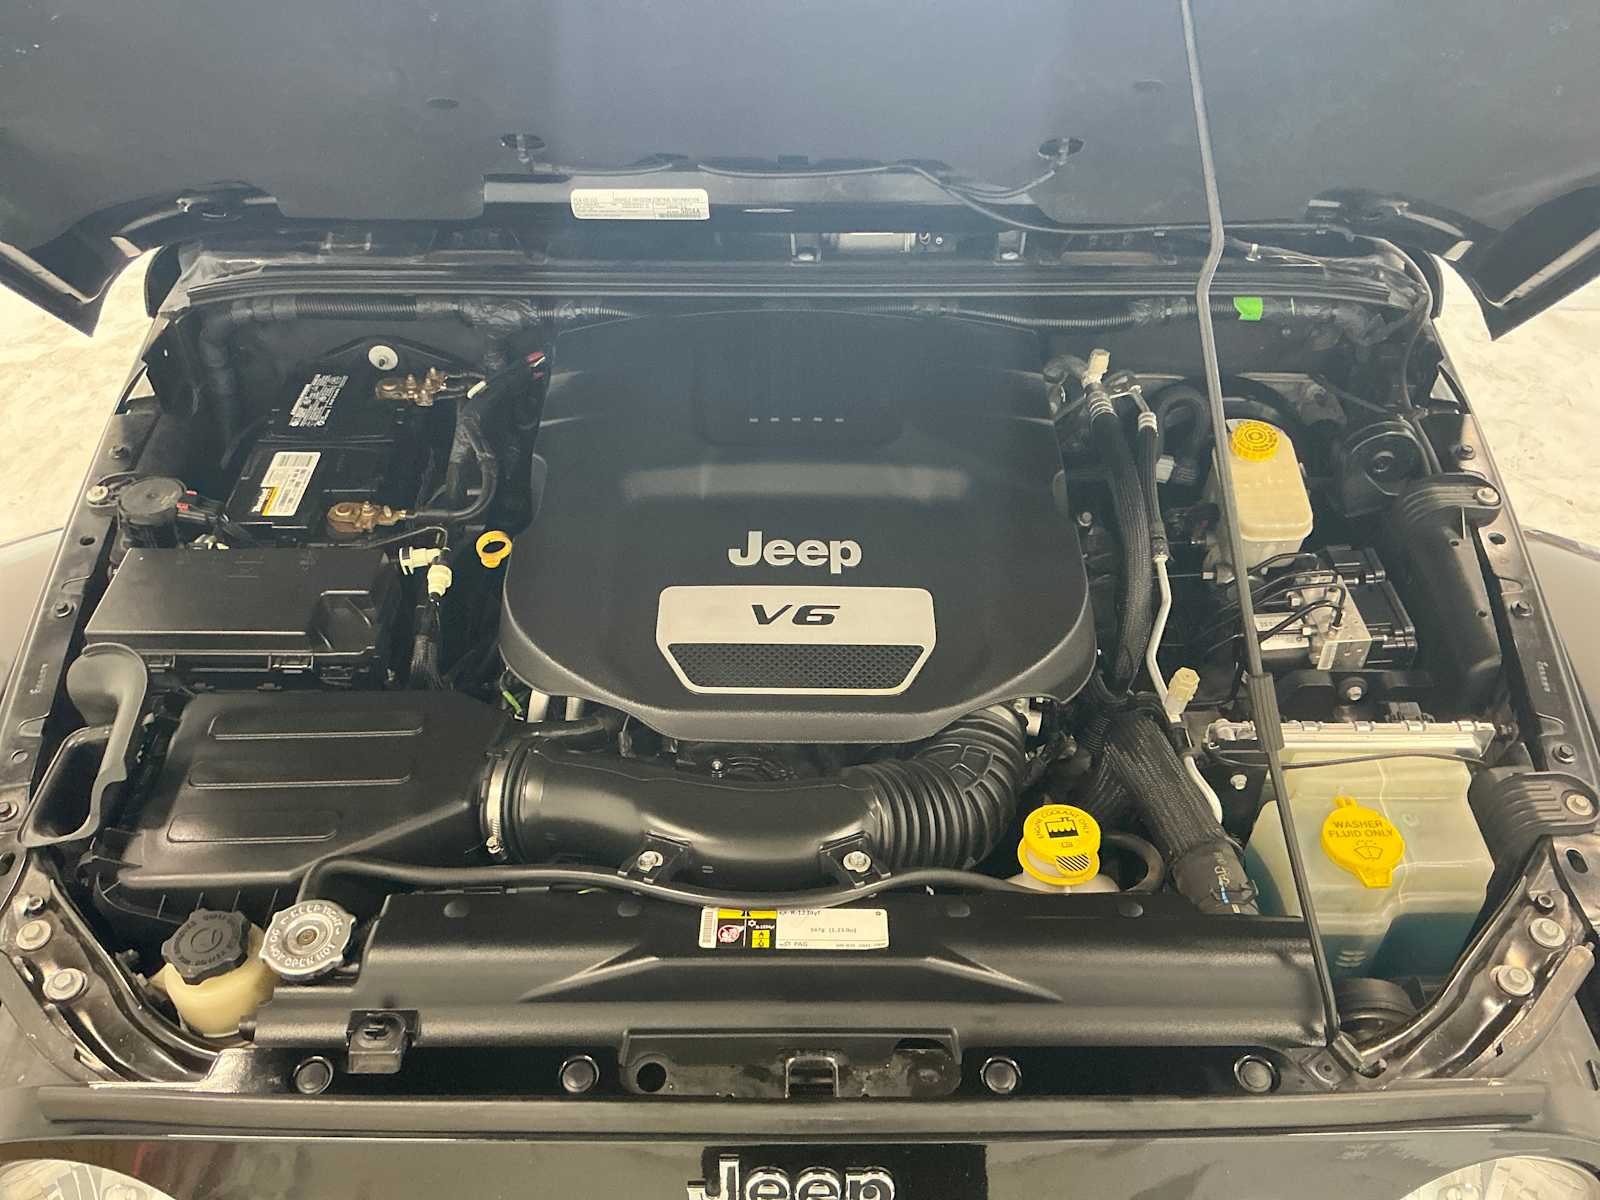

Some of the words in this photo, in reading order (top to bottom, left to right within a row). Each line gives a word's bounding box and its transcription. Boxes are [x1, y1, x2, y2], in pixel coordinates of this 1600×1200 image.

[728, 531, 862, 575] Jeep
[751, 604, 840, 625] V6
[1328, 829, 1362, 839] FLUID
[1364, 828, 1394, 839] ONLY
[1333, 819, 1383, 829] WASHER
[285, 956, 316, 968] OPEN
[316, 943, 336, 961] HOT
[687, 1154, 896, 1200] Jeep
